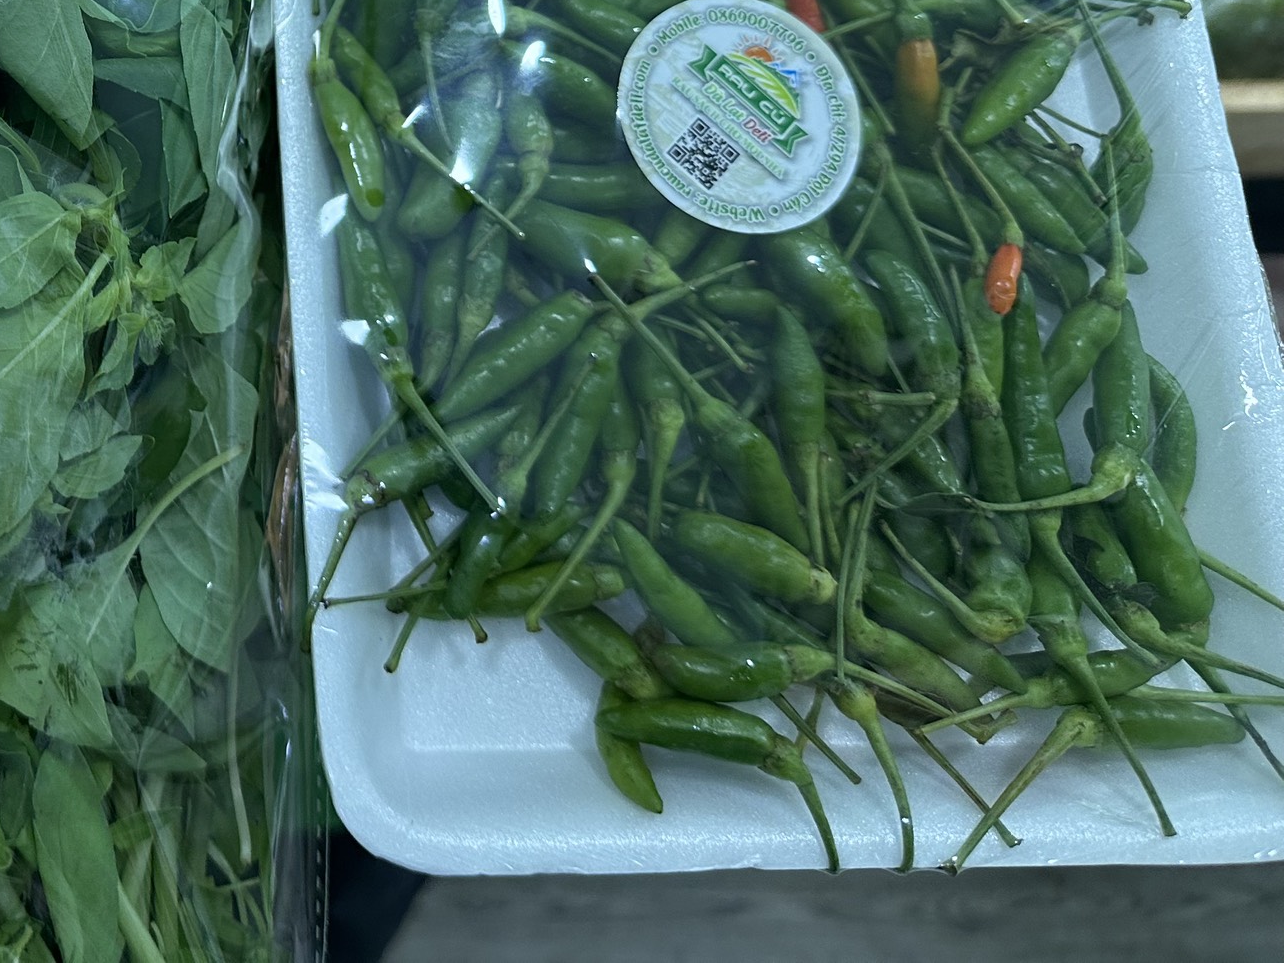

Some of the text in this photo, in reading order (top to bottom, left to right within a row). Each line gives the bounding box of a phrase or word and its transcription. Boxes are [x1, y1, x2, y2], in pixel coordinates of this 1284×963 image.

[708, 9, 806, 54] 0869007796
[718, 65, 756, 98] RAU
[743, 118, 772, 142] Deli
[823, 126, 846, 173] 4/294
